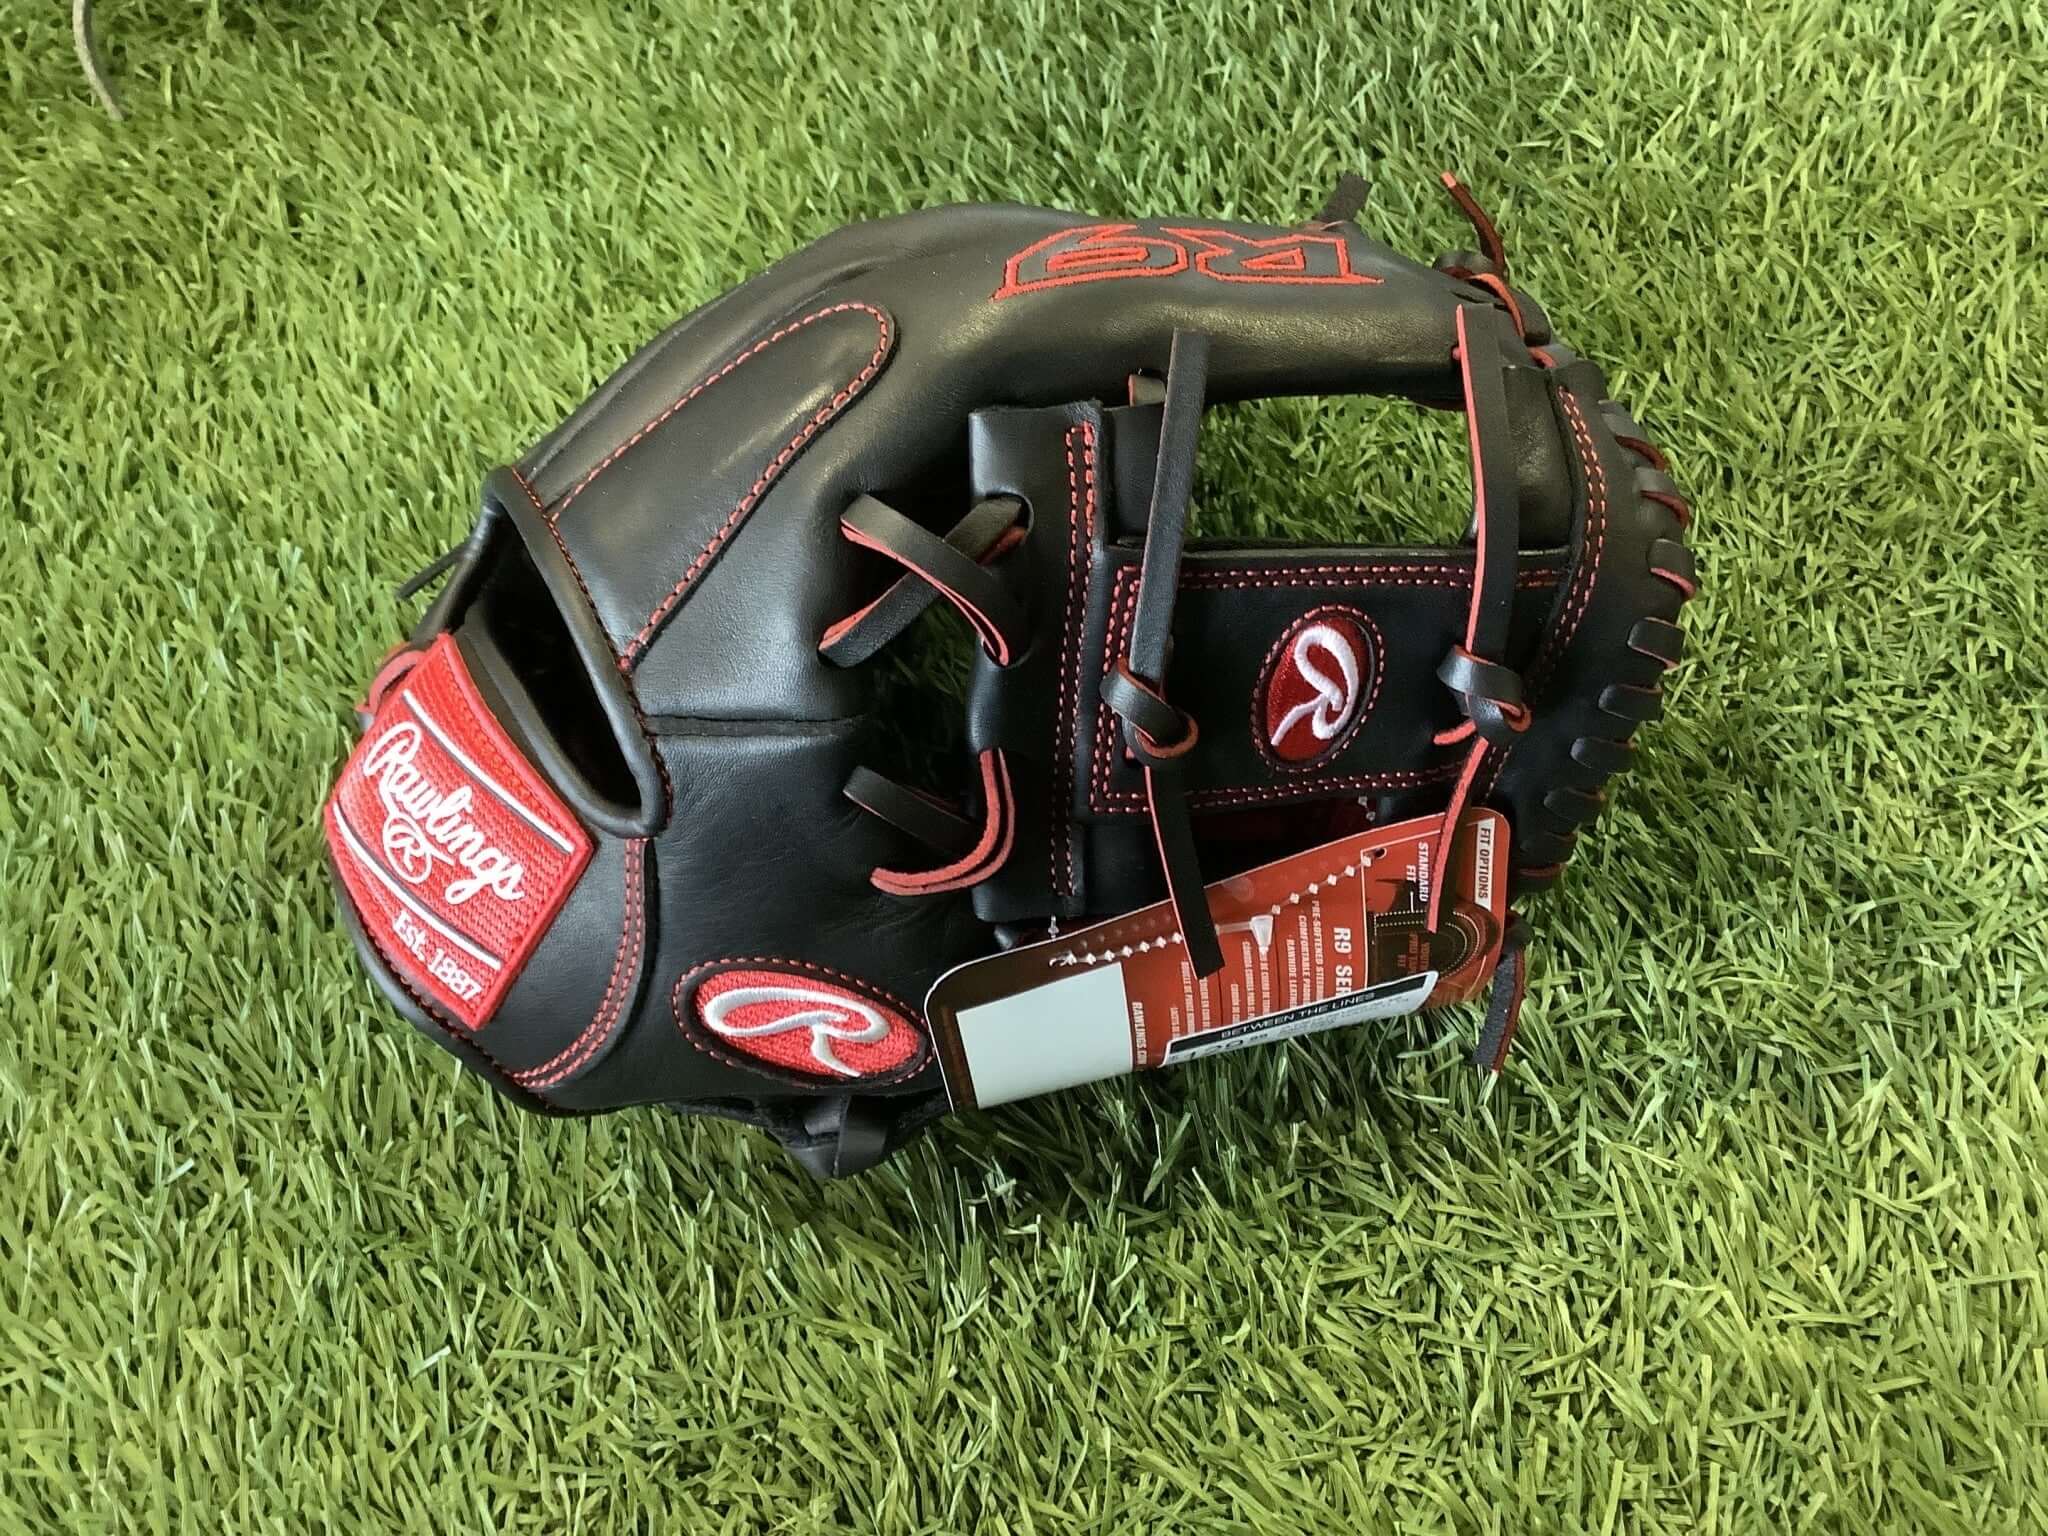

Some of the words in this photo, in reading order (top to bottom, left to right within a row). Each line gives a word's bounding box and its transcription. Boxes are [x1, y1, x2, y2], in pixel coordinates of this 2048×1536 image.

[363, 721, 526, 905] Rawlings
[1480, 827, 1491, 846] FIT
[1406, 864, 1417, 883] FIT
[1418, 841, 1429, 902] STANDARD
[1478, 849, 1490, 899] OPTIONS
[392, 909, 426, 961] Est.
[427, 948, 483, 1001] 1887
[1298, 915, 1310, 977] COMFORTABLE
[1333, 927, 1352, 954] R9
[1220, 1014, 1295, 1039] BETWEEN
[1300, 1003, 1329, 1018] THE
[1332, 991, 1375, 1009] LINES
